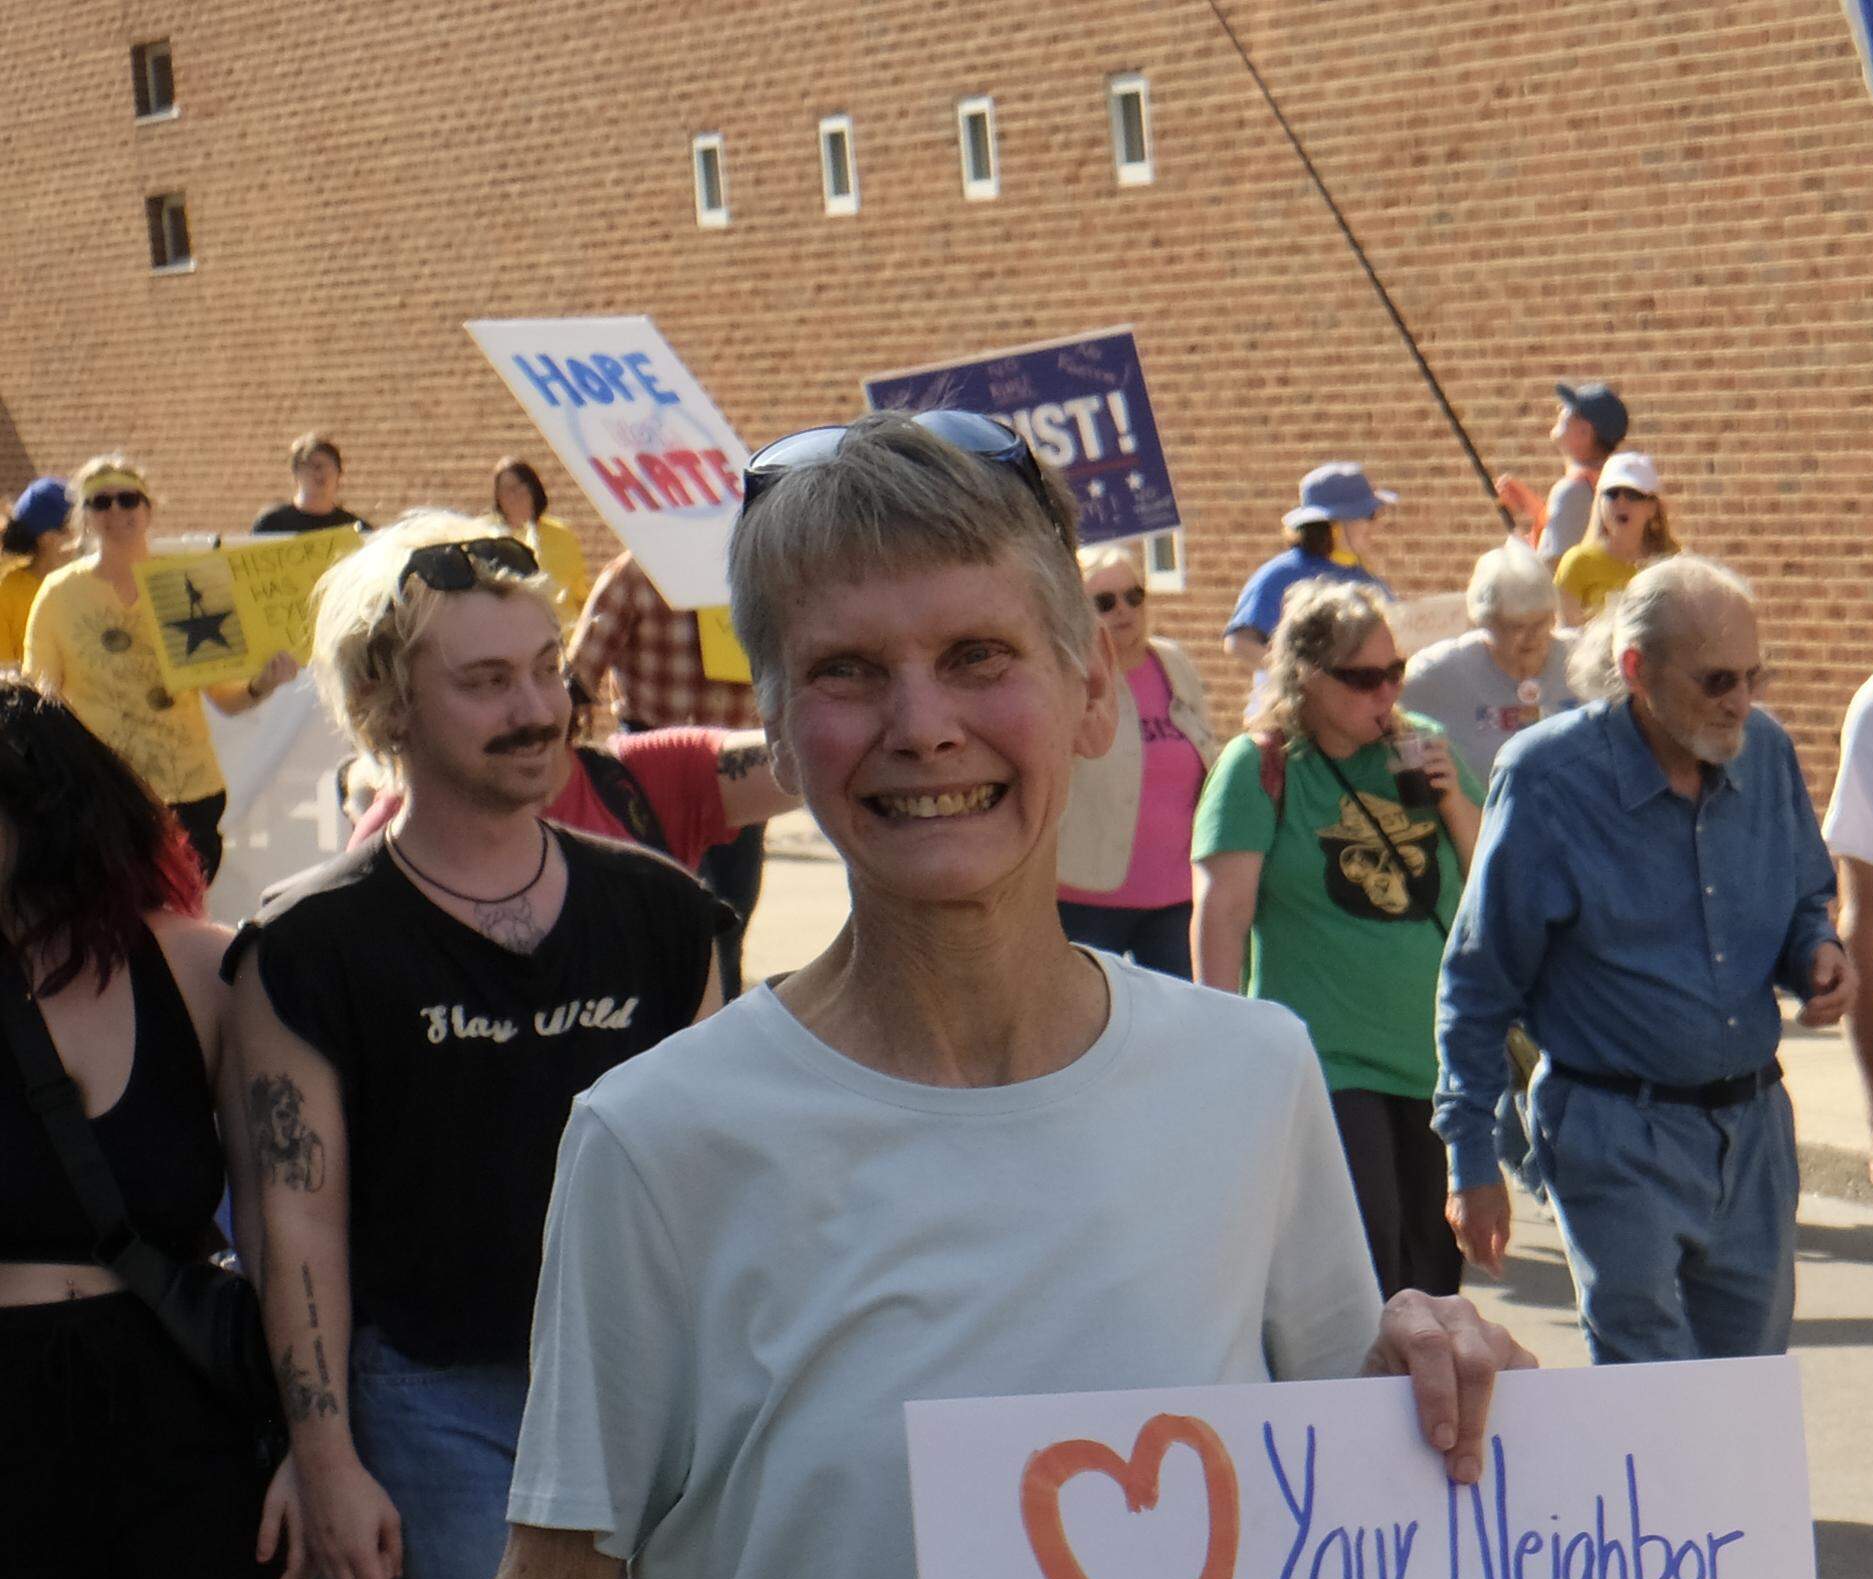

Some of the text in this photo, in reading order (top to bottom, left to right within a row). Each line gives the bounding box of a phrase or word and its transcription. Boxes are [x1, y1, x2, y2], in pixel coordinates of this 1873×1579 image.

[511, 352, 681, 408] HOPE
[588, 448, 744, 513] HATE
[534, 996, 639, 1036] Wild
